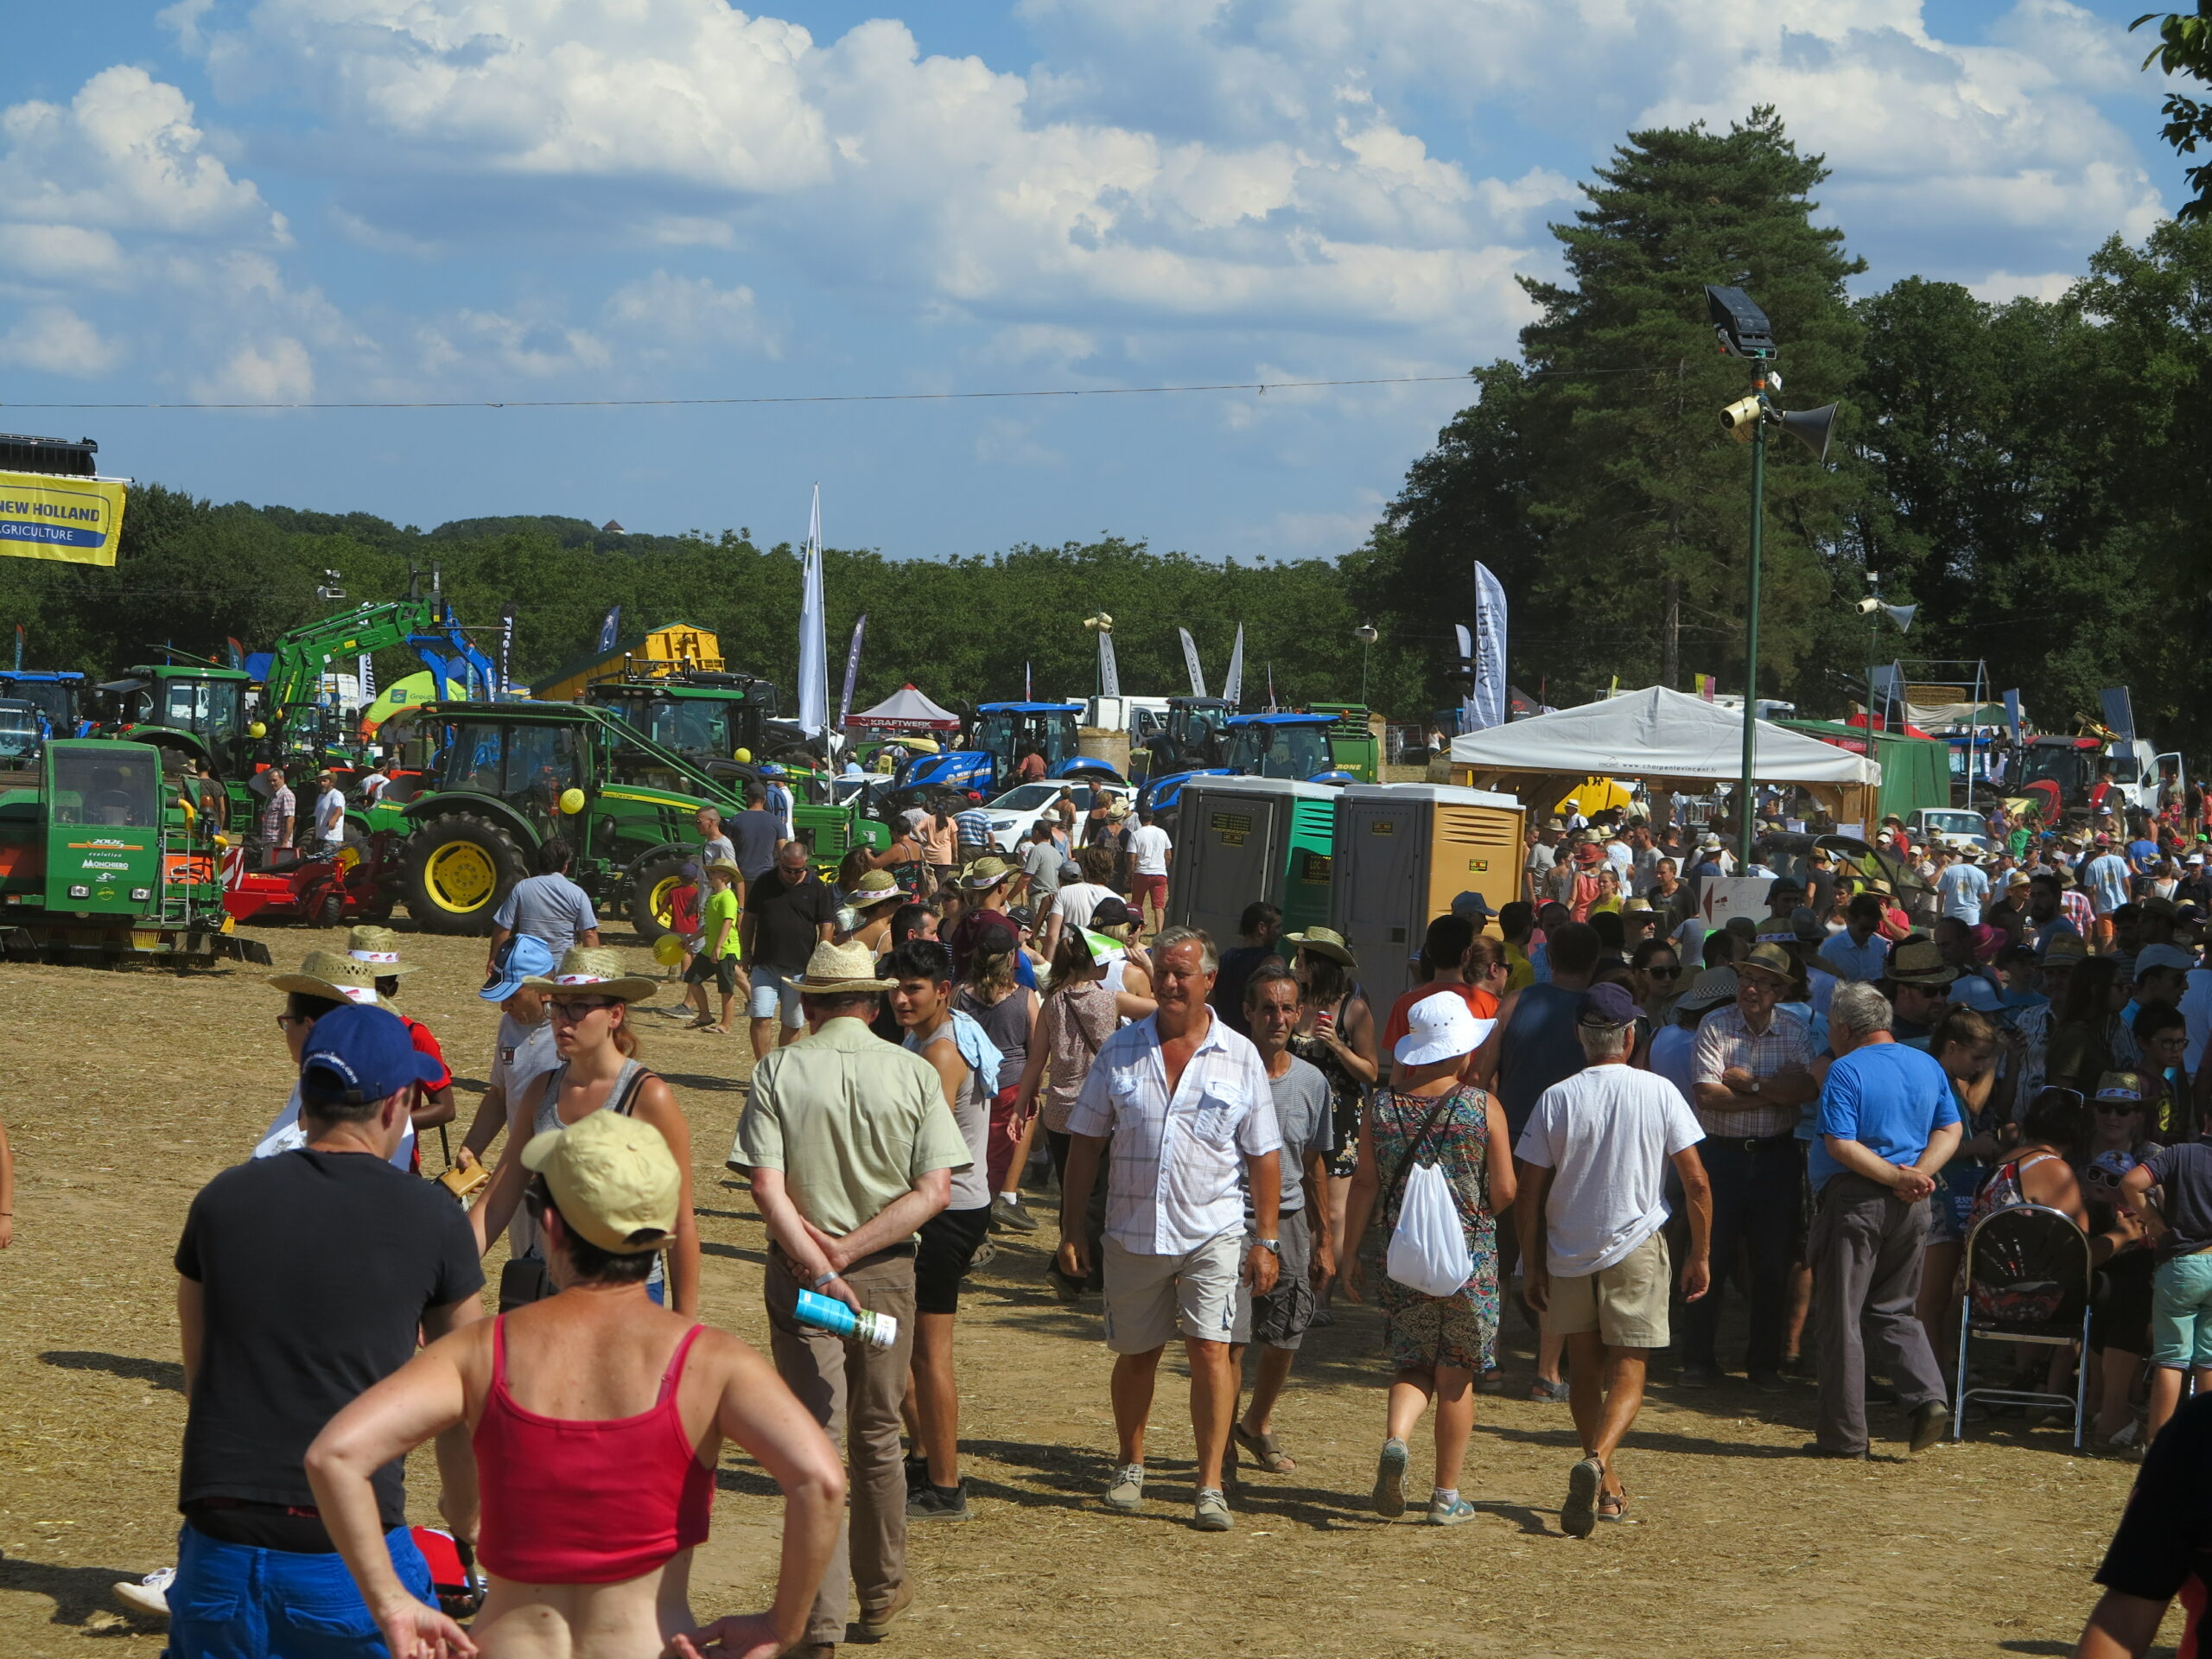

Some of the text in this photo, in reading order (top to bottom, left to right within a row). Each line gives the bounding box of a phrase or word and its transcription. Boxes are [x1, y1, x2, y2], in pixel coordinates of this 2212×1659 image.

[33, 502, 99, 522] HOLLAND
[0, 524, 73, 541] GRICULTURE
[871, 719, 931, 728] KRAFTWERK
[1623, 763, 1717, 773] www.charpentevincent.fr
[82, 859, 129, 868] MONCHIERO
[1729, 891, 1770, 910] REPA
